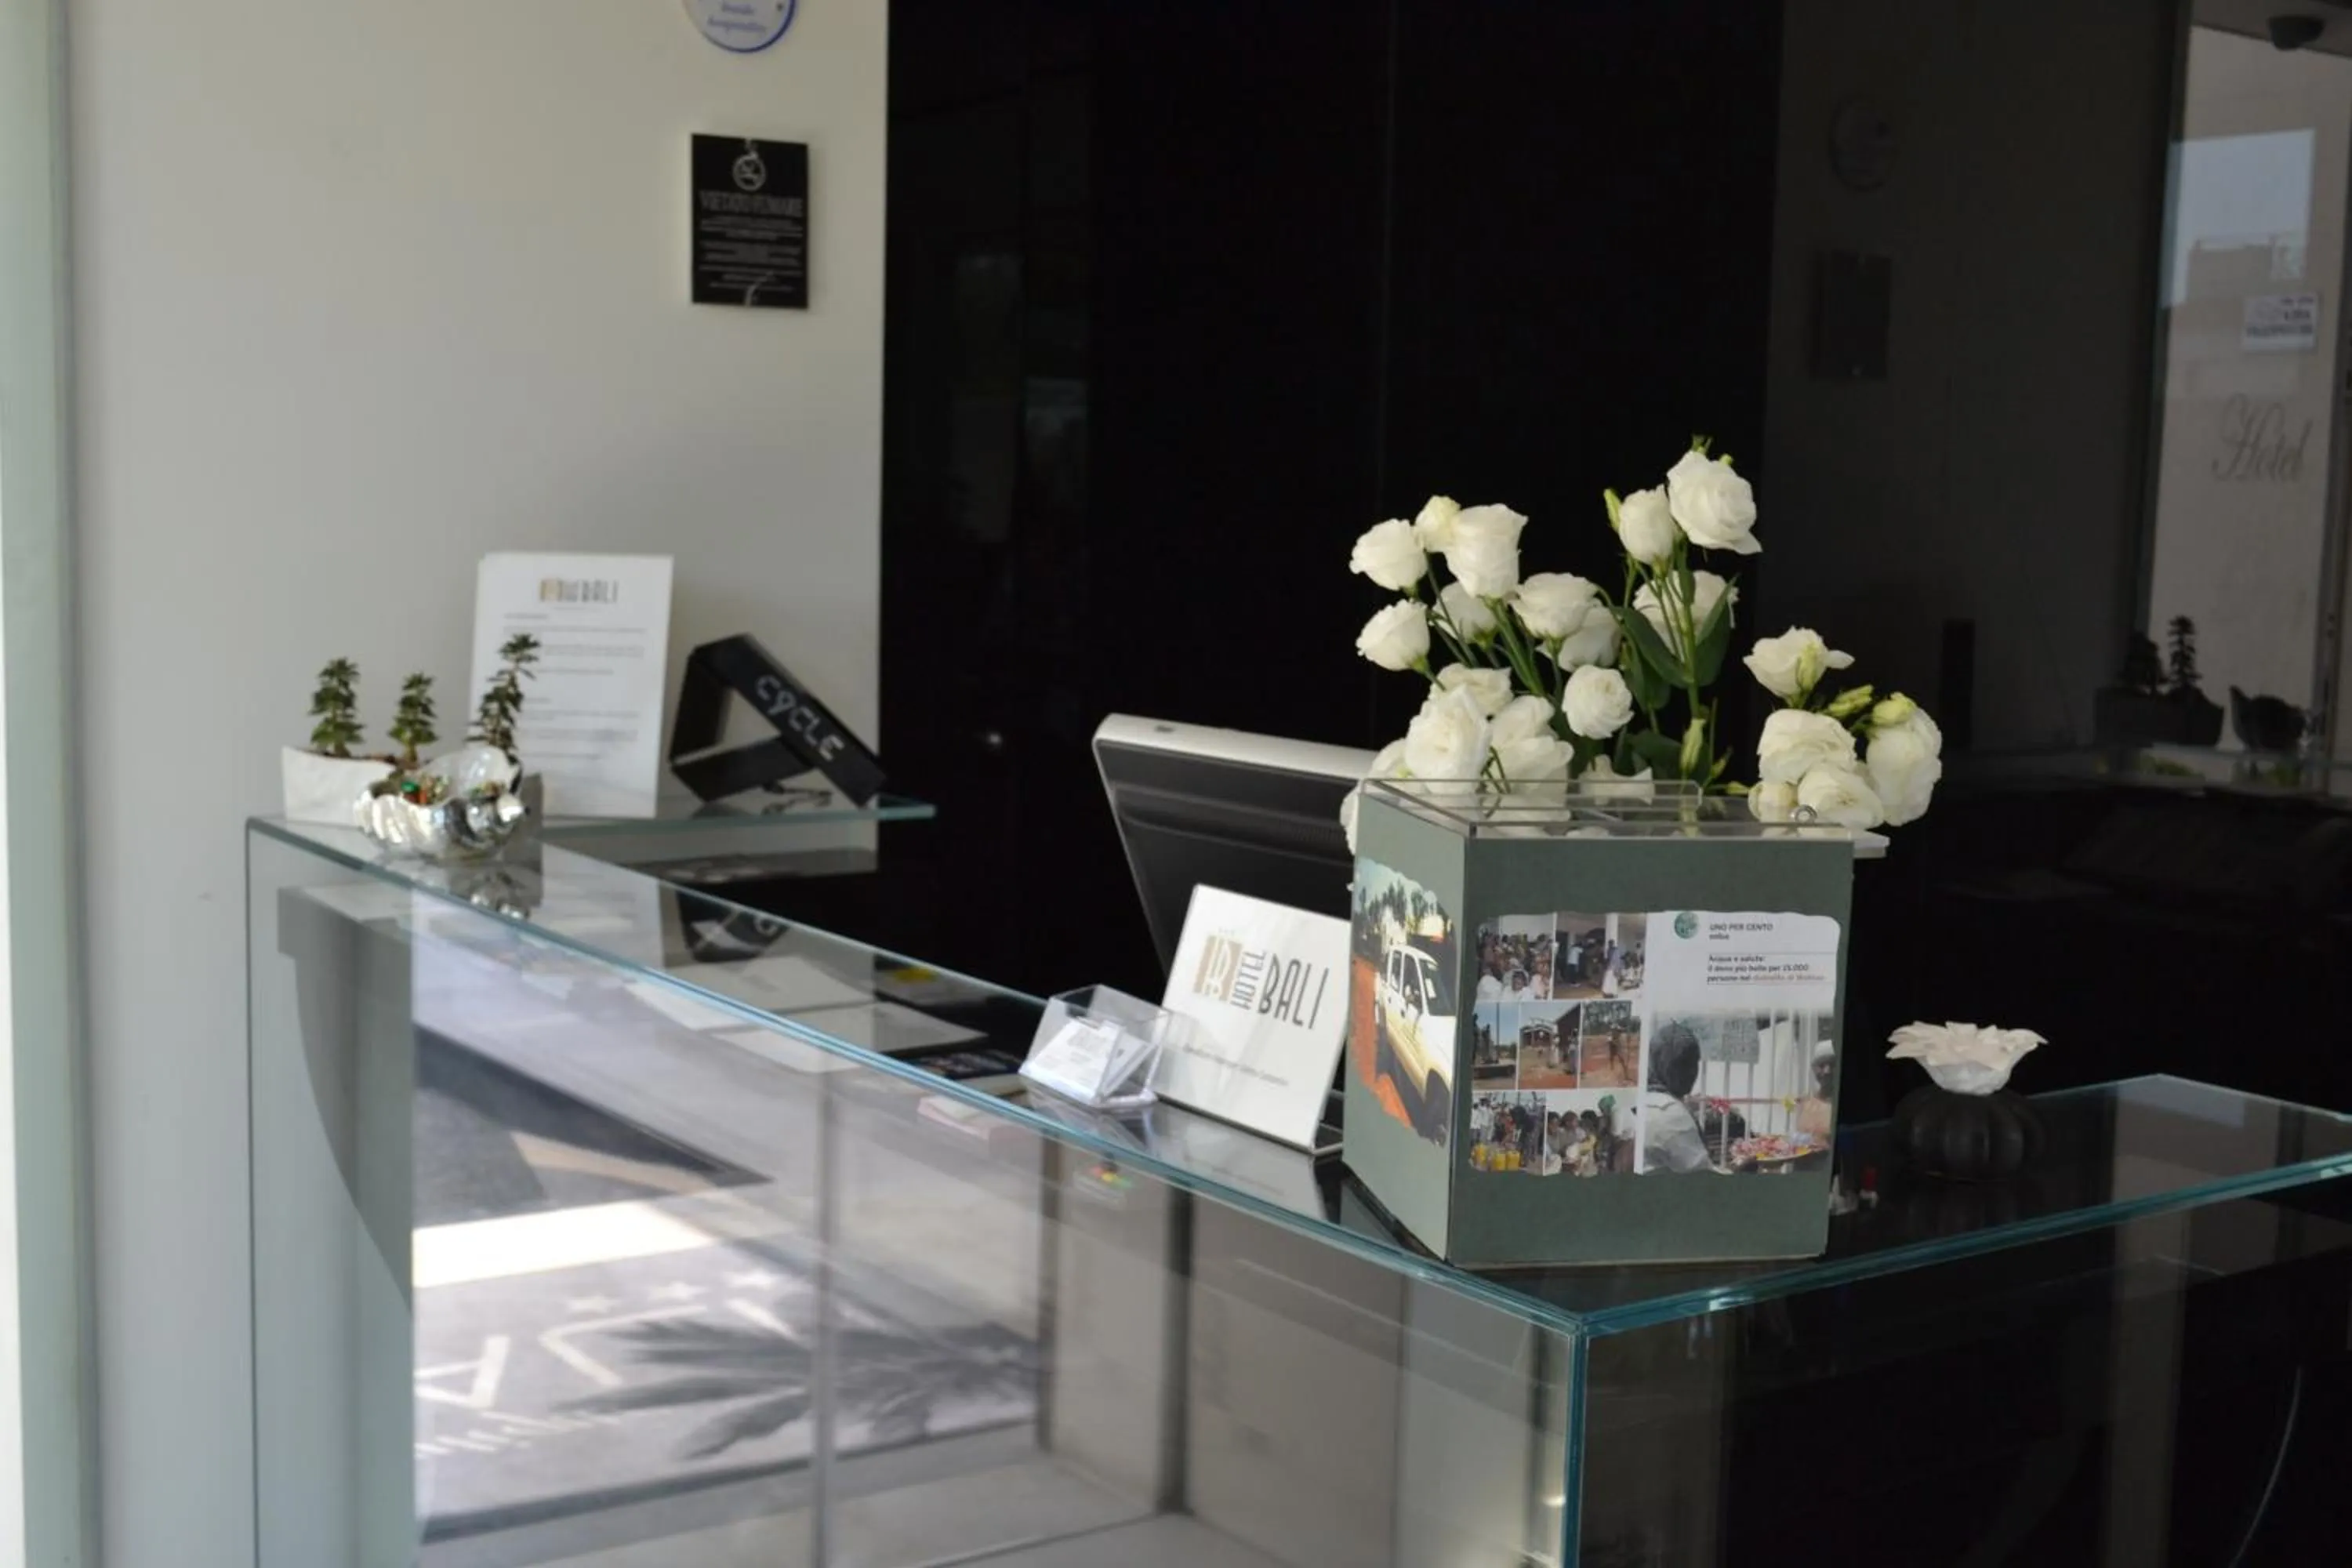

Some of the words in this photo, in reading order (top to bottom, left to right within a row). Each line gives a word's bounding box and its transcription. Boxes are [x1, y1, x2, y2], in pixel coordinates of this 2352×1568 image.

[1709, 923, 1727, 932] UNO
[1729, 923, 1744, 932] PER
[1746, 923, 1773, 933] CENTO
[1229, 949, 1267, 1011] HOTEL
[1257, 953, 1330, 1029] BALI
